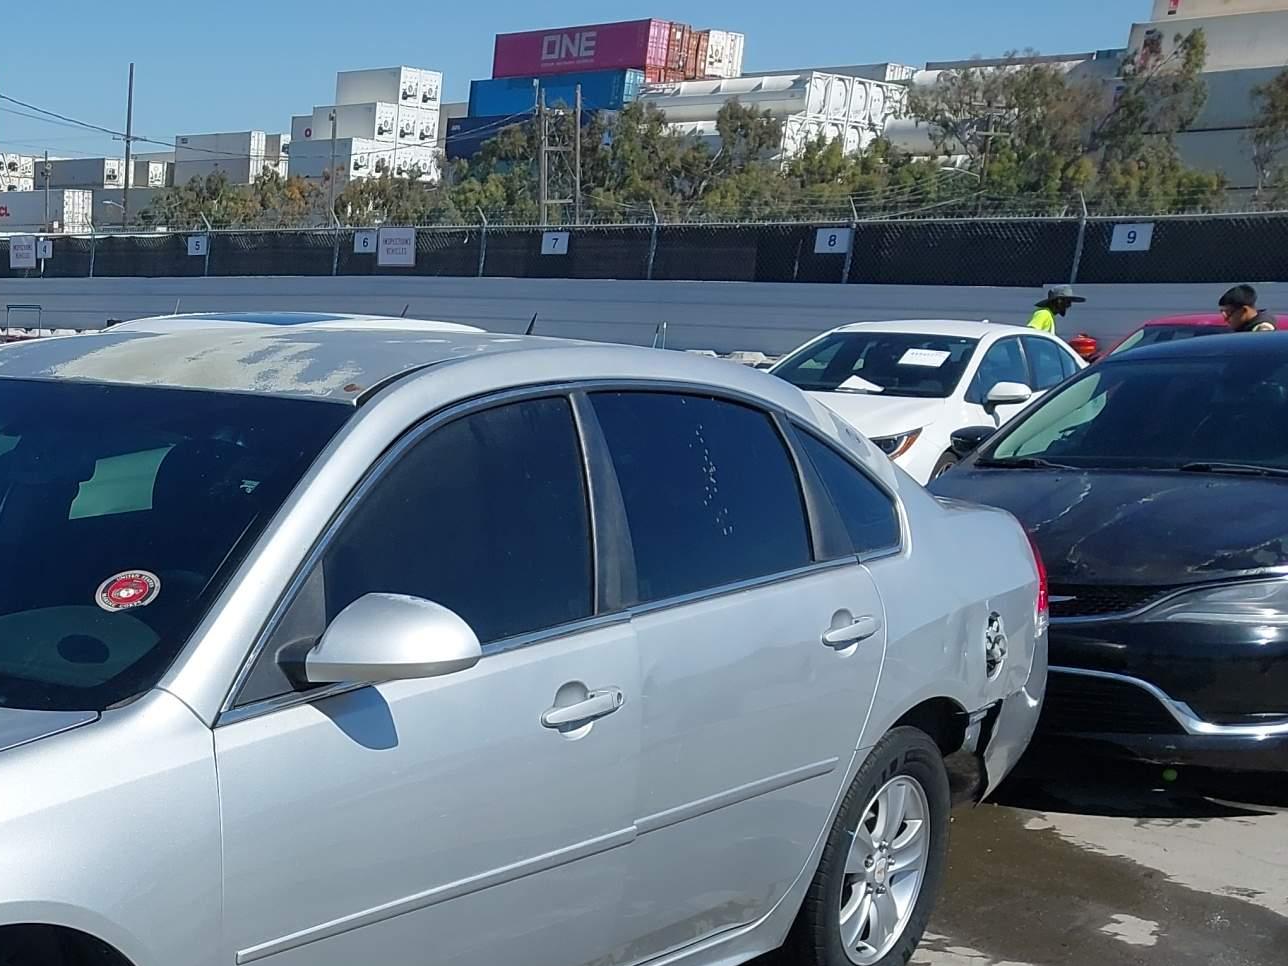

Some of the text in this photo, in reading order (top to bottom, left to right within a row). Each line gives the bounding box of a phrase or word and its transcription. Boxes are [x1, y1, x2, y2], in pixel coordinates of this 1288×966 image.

[541, 31, 598, 61] ONE
[362, 237, 369, 248] 6
[551, 237, 559, 250] 7
[827, 234, 837, 248] 8
[1125, 230, 1137, 245] 9
[42, 245, 47, 255] 4
[194, 241, 201, 251] 5
